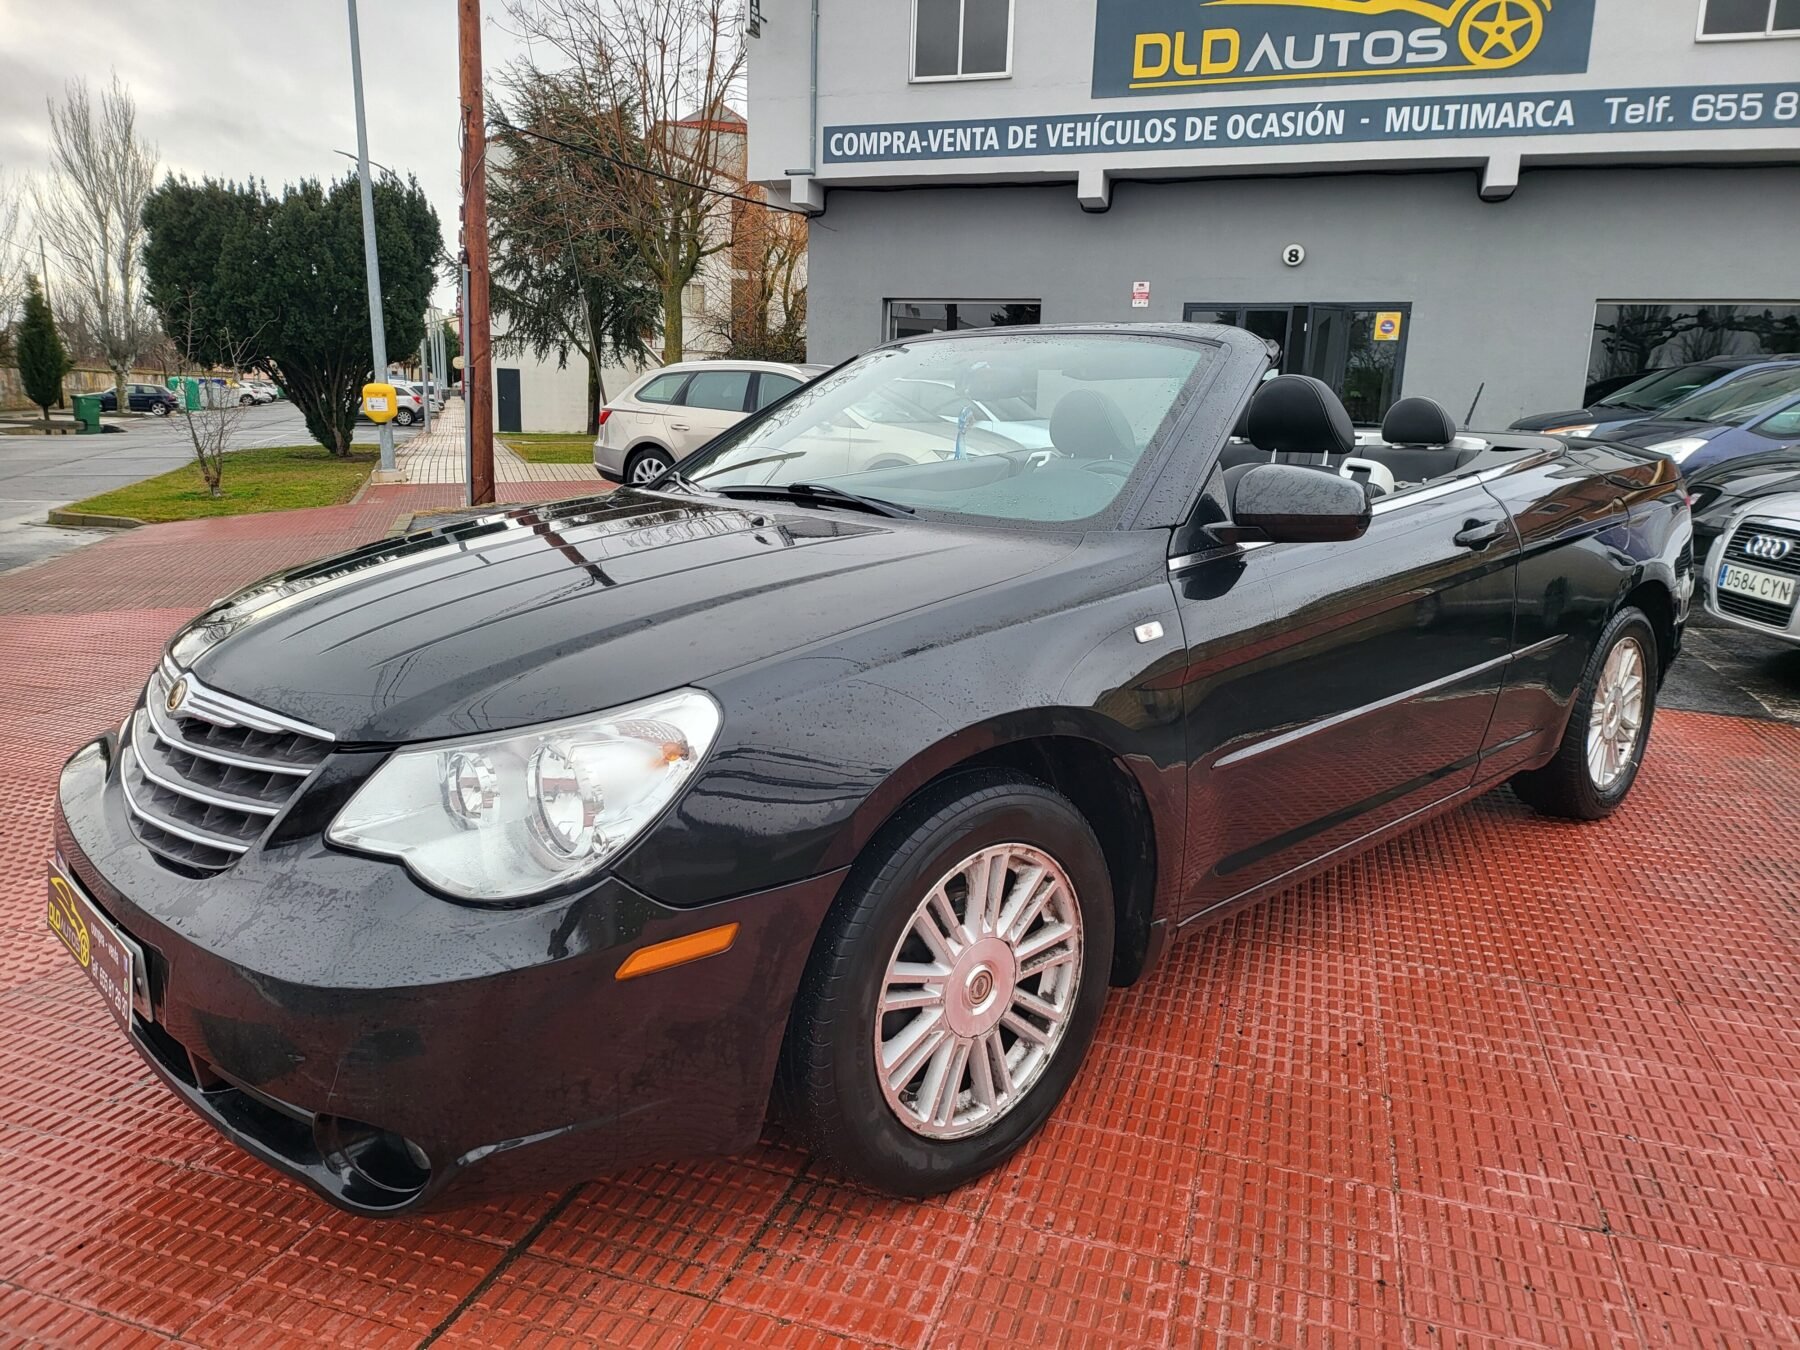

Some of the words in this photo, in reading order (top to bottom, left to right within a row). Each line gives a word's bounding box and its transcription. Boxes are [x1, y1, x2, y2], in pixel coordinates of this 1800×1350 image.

[1133, 28, 1240, 79] DLD
[1243, 27, 1448, 73] AUTOS
[830, 126, 999, 157] COMPRA-VENTA
[1007, 124, 1038, 150] DE
[1046, 114, 1177, 148] VEHÍCULOS
[1184, 115, 1218, 142] DE
[1226, 103, 1345, 141] OCASIÓN
[1384, 99, 1575, 133] MULTIMARCA
[1604, 95, 1674, 125] Telf.
[1691, 93, 1764, 122] 655
[1287, 248, 1300, 263] 8
[1726, 569, 1757, 592] 0584
[1760, 577, 1792, 601] CYN
